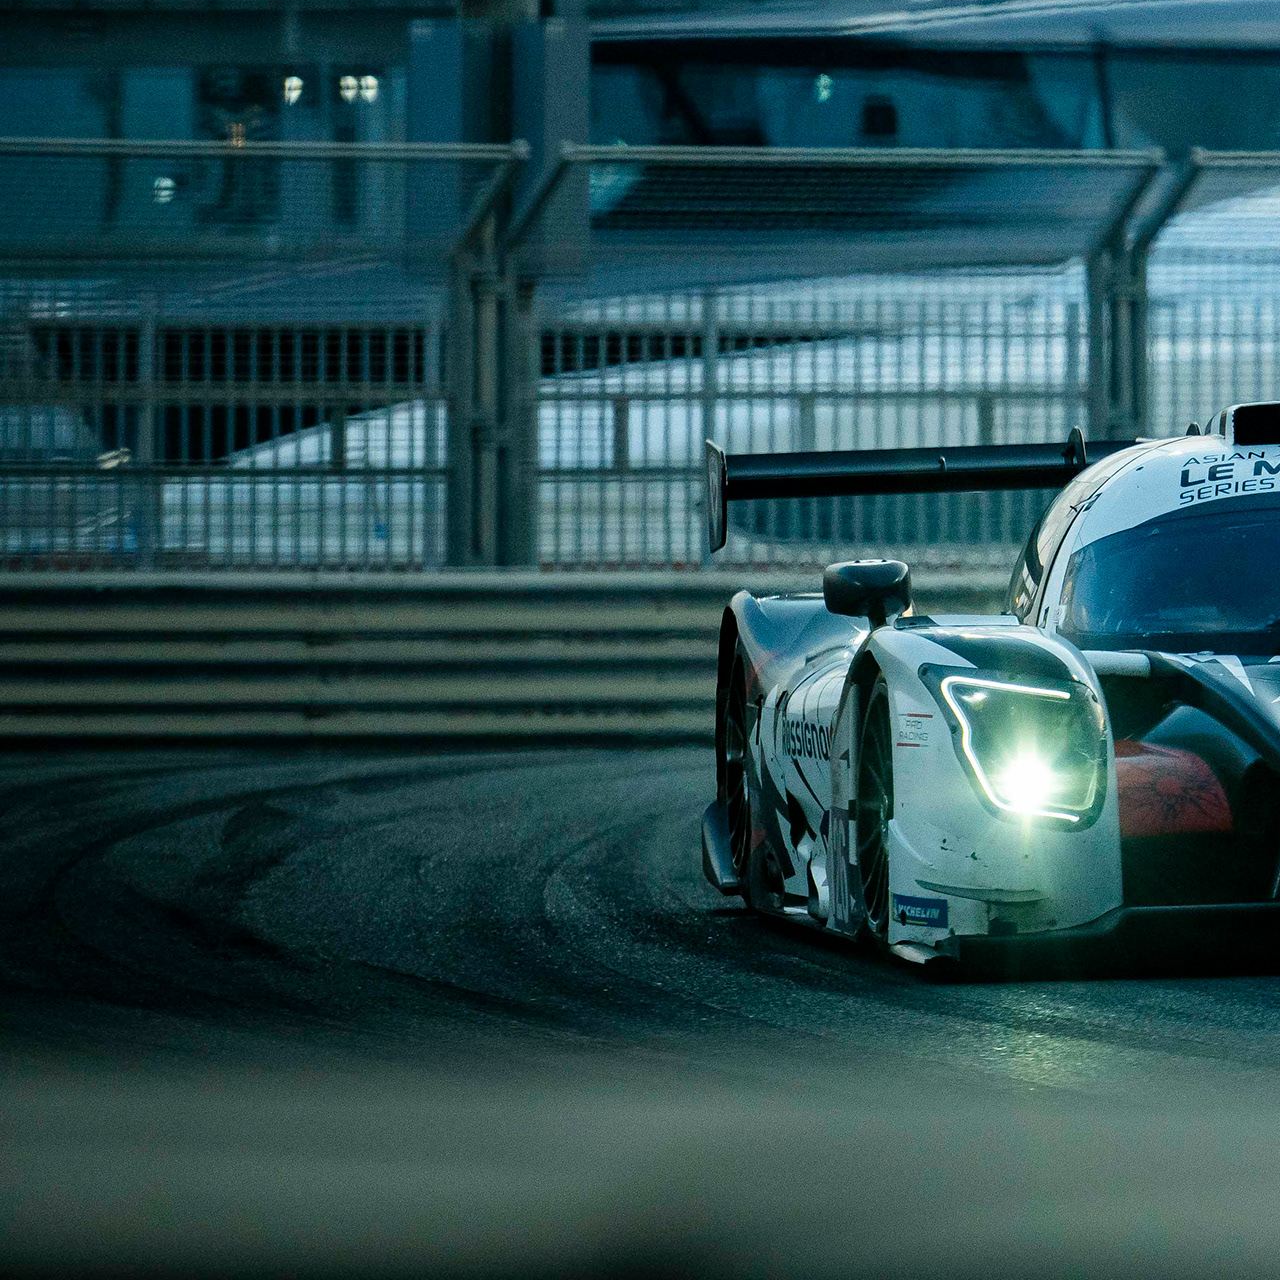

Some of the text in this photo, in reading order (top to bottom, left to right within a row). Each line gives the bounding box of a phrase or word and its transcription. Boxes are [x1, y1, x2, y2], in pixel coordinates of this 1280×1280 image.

[1182, 451, 1266, 468] ASIAN
[1180, 462, 1235, 488] LE
[1179, 477, 1276, 506] SERIES
